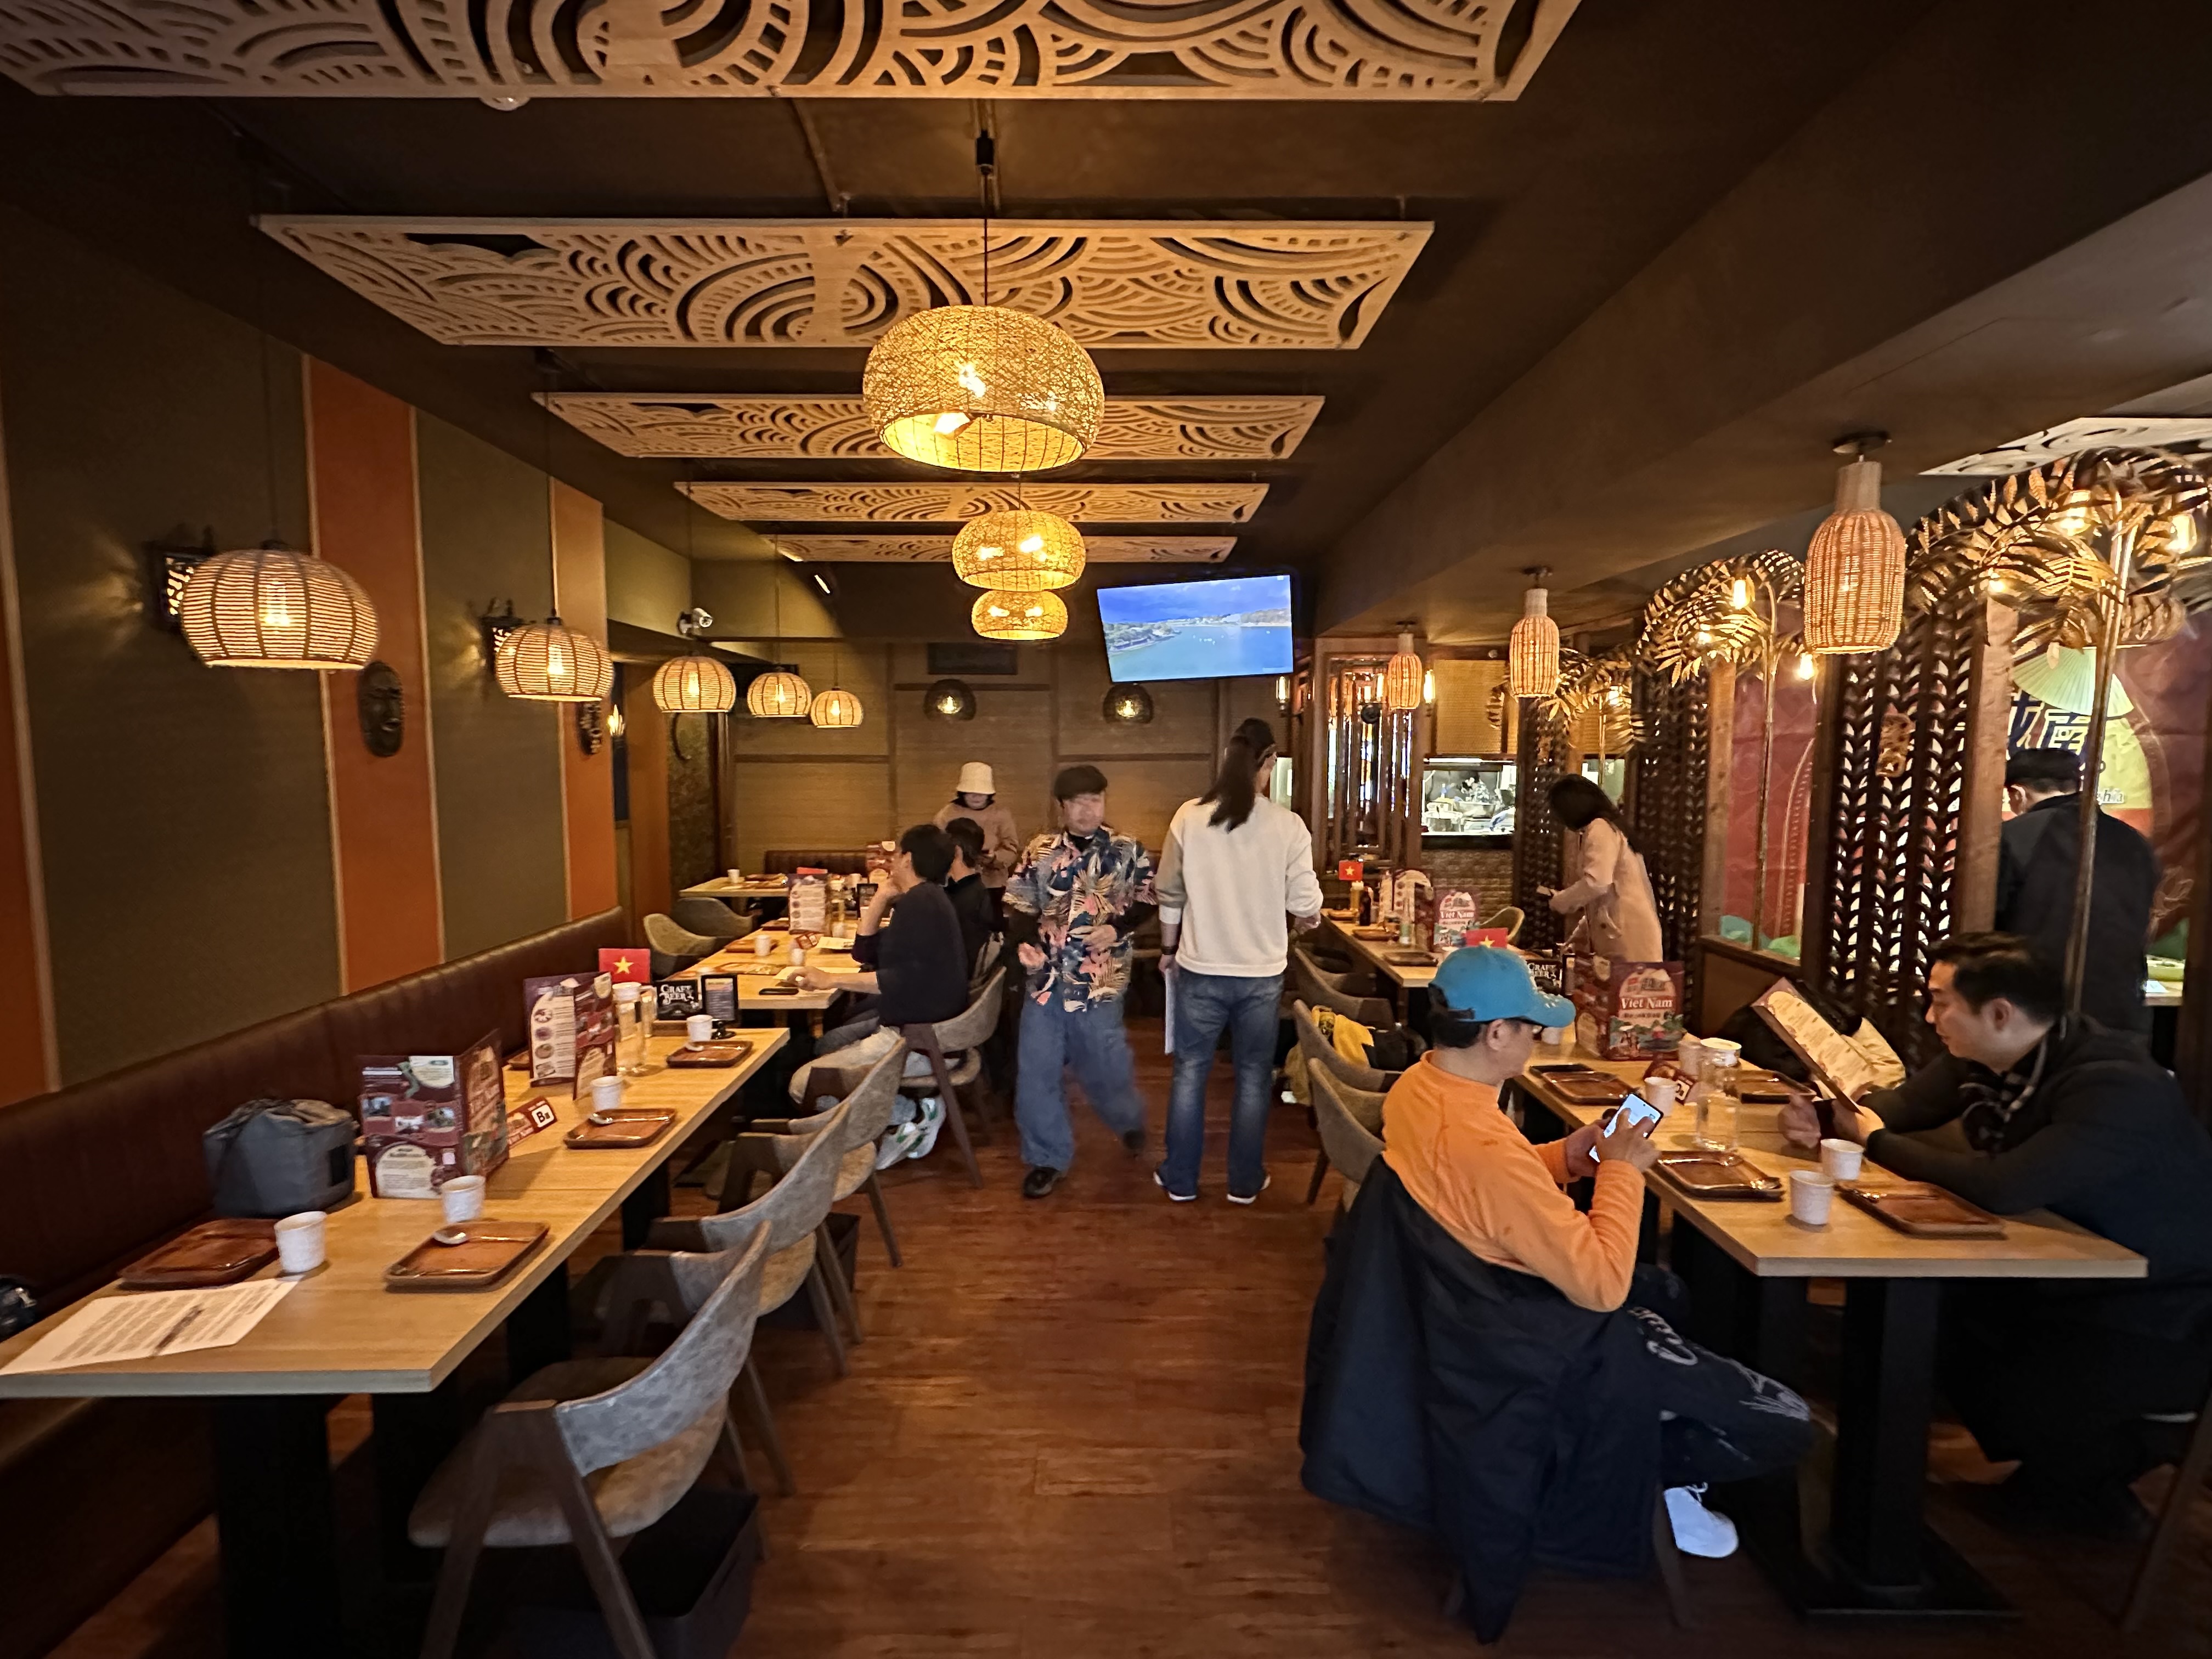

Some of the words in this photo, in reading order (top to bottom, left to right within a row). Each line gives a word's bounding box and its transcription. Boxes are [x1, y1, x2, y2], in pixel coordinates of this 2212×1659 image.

[661, 984, 692, 993] CRAFT
[659, 992, 688, 1005] BEER
[1646, 998, 1673, 1008] Nam
